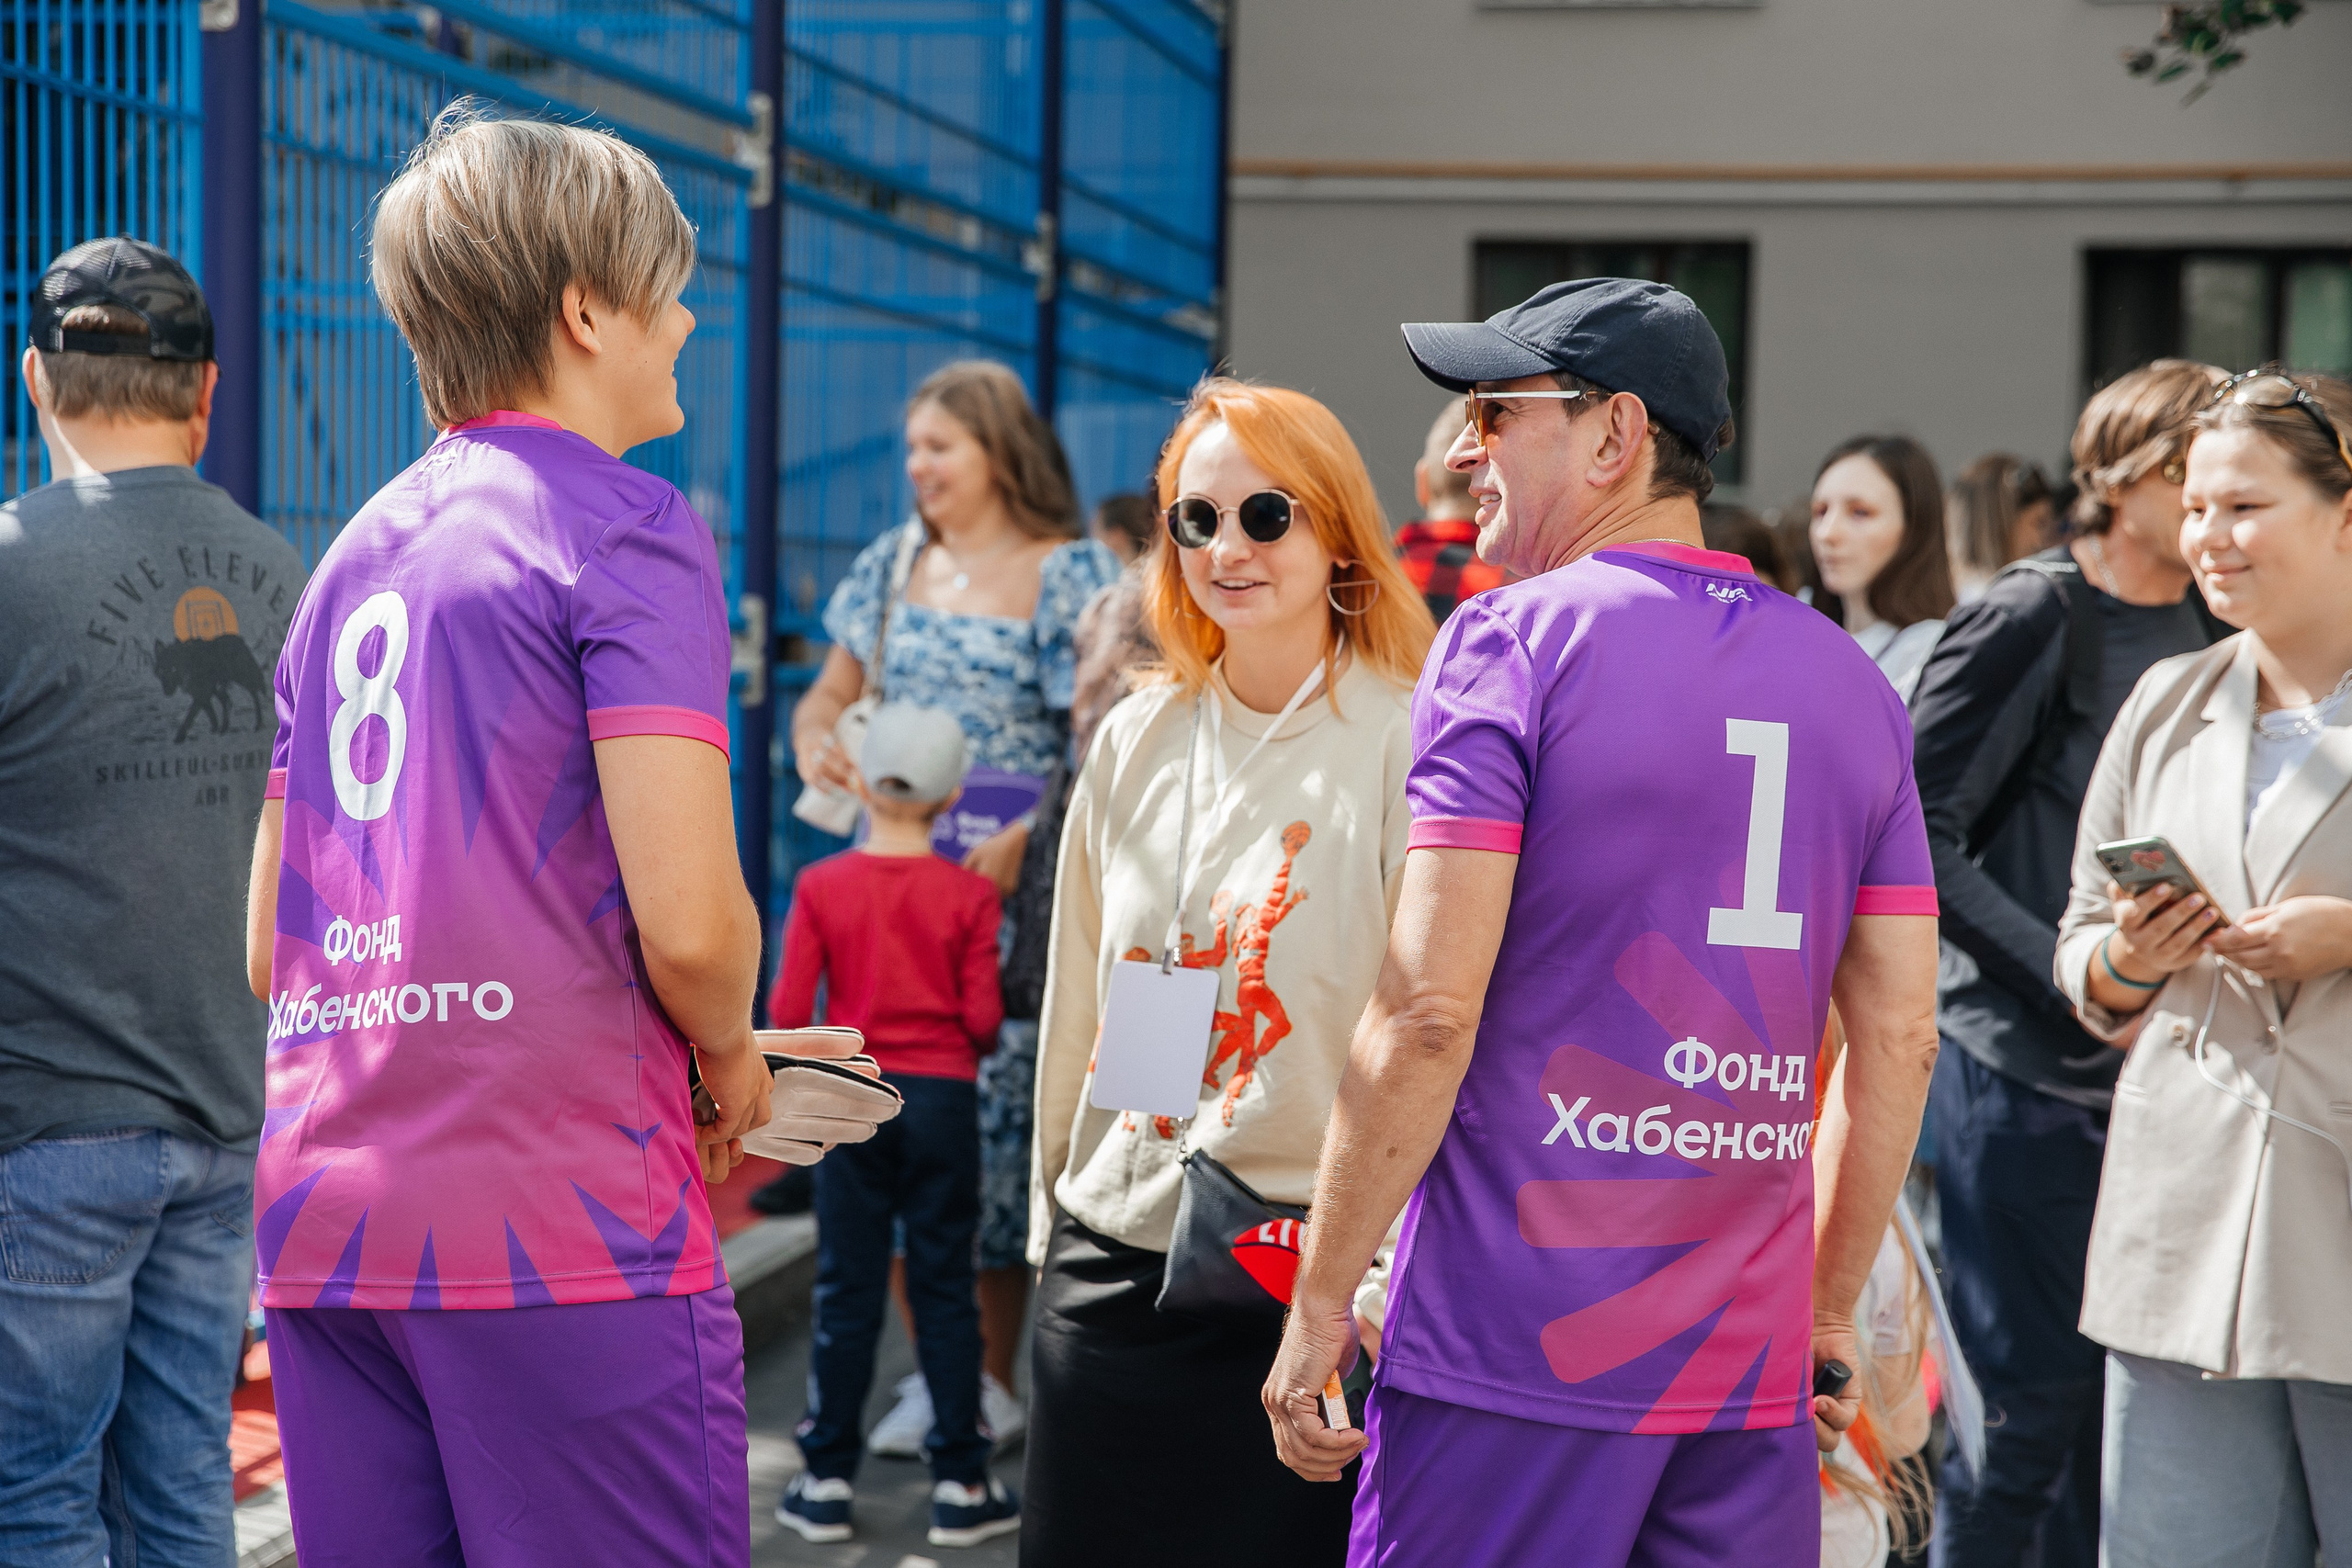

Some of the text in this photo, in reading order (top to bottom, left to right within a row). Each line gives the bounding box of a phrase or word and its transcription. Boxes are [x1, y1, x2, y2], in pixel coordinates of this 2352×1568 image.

[86, 545, 293, 646] FIVE ELEVE
[329, 590, 410, 821] 8
[1706, 717, 1804, 951] 1
[323, 914, 402, 966] Фонд
[266, 980, 514, 1041] Хабенского
[1663, 1036, 1806, 1101] Фонд
[1541, 1092, 1815, 1161] Хабенско
